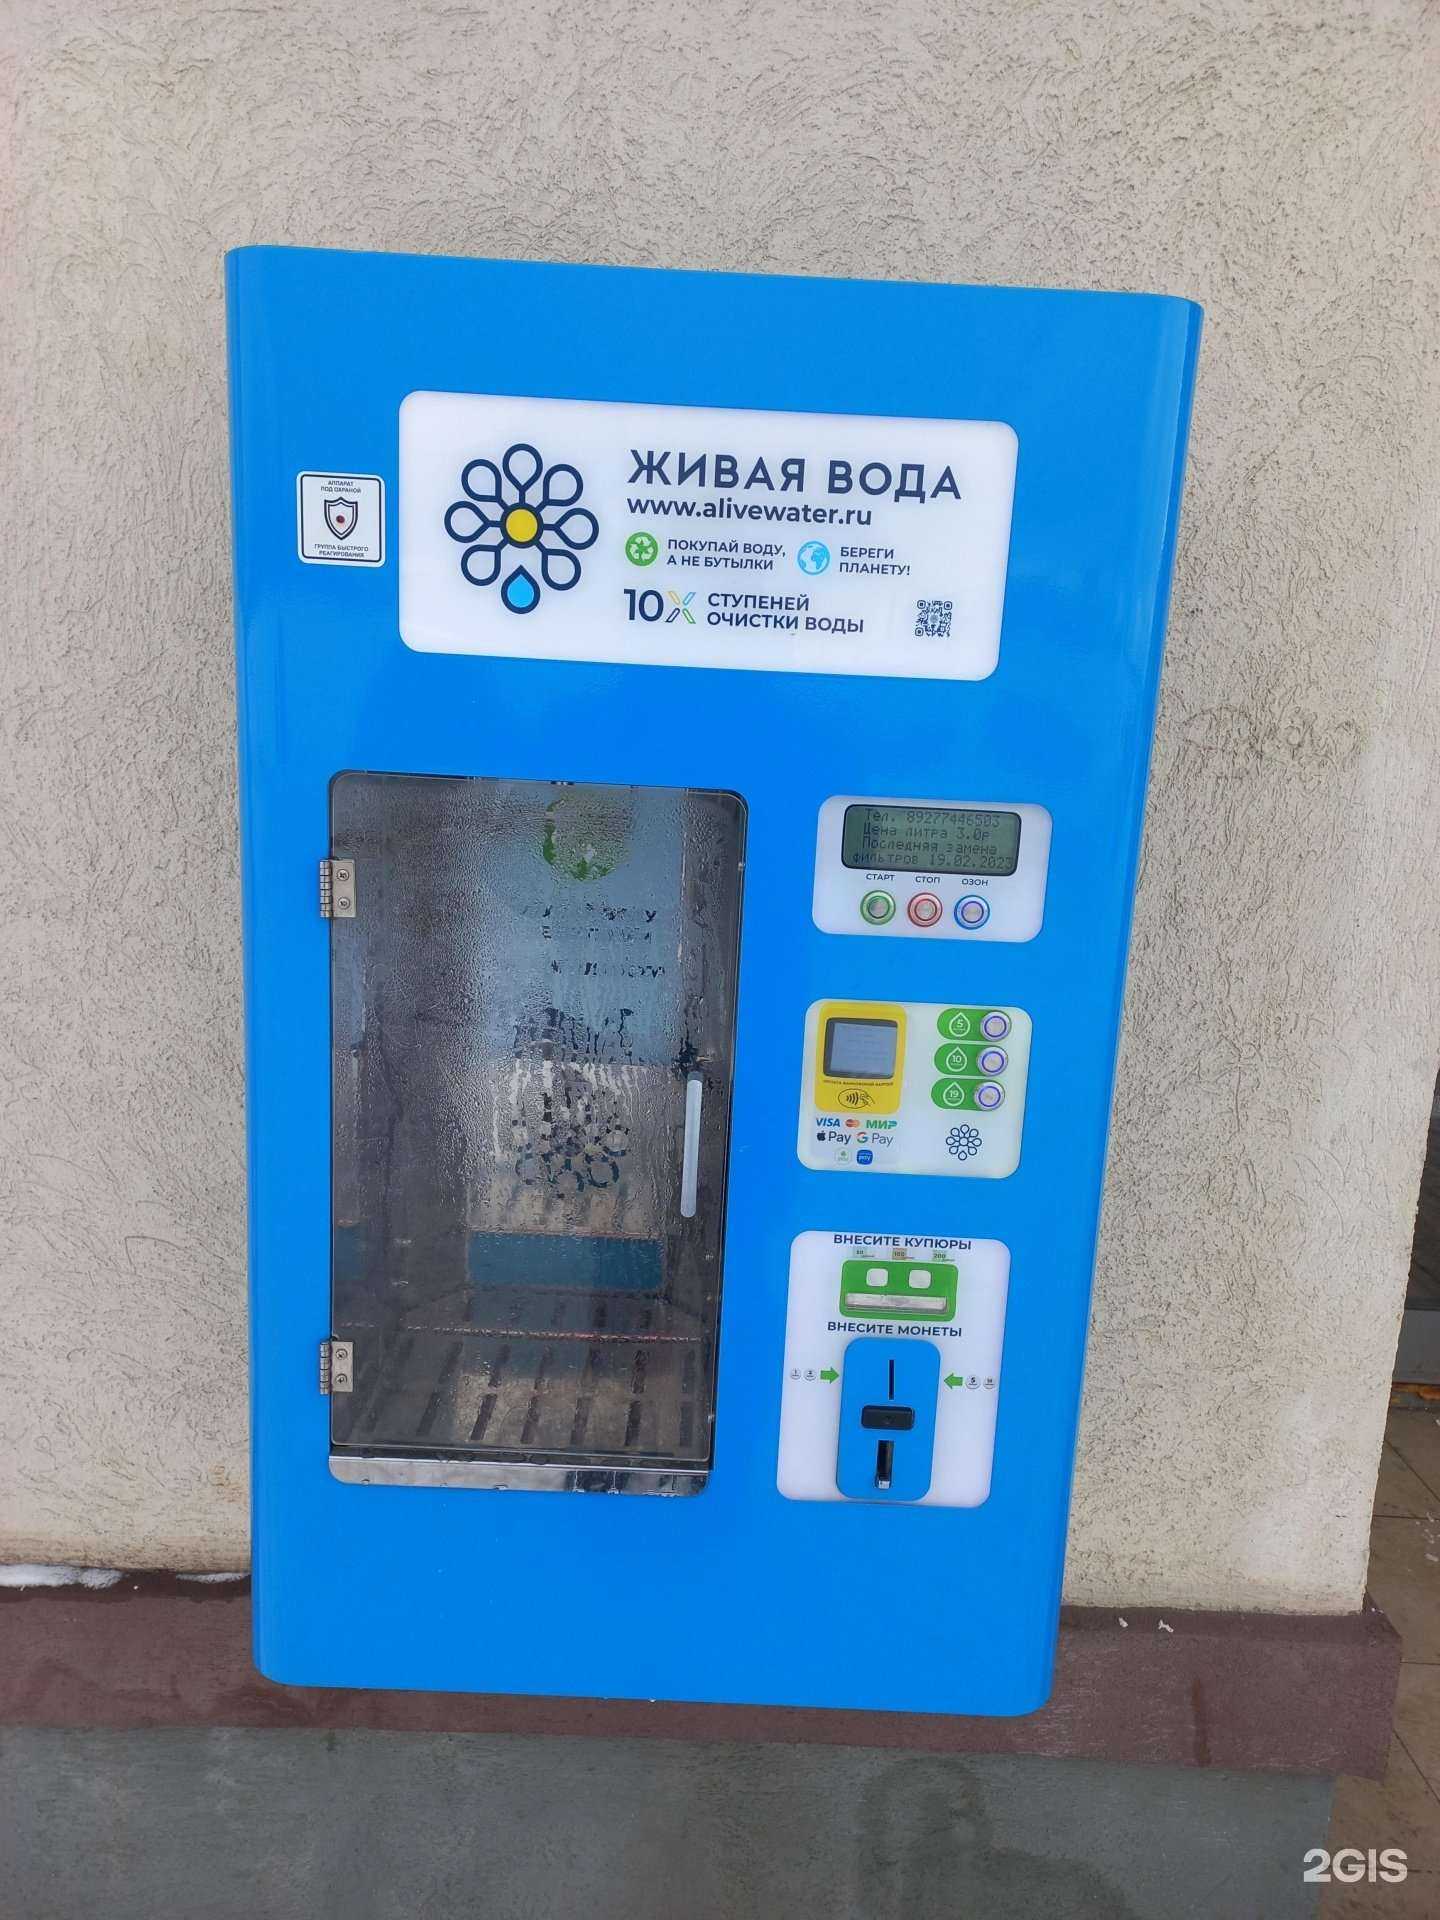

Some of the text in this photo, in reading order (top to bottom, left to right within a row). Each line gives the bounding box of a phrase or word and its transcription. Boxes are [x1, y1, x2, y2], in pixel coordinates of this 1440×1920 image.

[627, 449, 962, 503] ЖИВАЯ ВОДА
[627, 497, 872, 526] www.alivewater.ru
[668, 539, 786, 558] ПОКУПАЙ ВОДУ,
[840, 547, 894, 560] БЕРЕГИ
[667, 555, 774, 571] А НЕ БУТЫЛКИ
[839, 562, 911, 576] ПЛАНЕТУ!
[708, 592, 809, 612] СТУПЕНЕЙ
[707, 612, 864, 634] ОЧИСТКИ ВОДЫ
[863, 822, 897, 838] Цена
[905, 827, 948, 839] литра
[863, 836, 938, 853] Последняя
[866, 873, 895, 882] СТАРТ
[915, 875, 941, 884] СТОП
[961, 878, 989, 886] ОЗОН
[957, 1019, 964, 1028] 5
[952, 1055, 962, 1063] 10
[949, 1089, 959, 1098] 19
[816, 1118, 841, 1127] VISA
[828, 1131, 852, 1145] Pay
[871, 1132, 894, 1148] Pay
[833, 1234, 972, 1250] ВНЕСИТЕ КУПЮРЫ
[827, 1321, 962, 1337] ВНЕСИТЕ МОНЕТЫ
